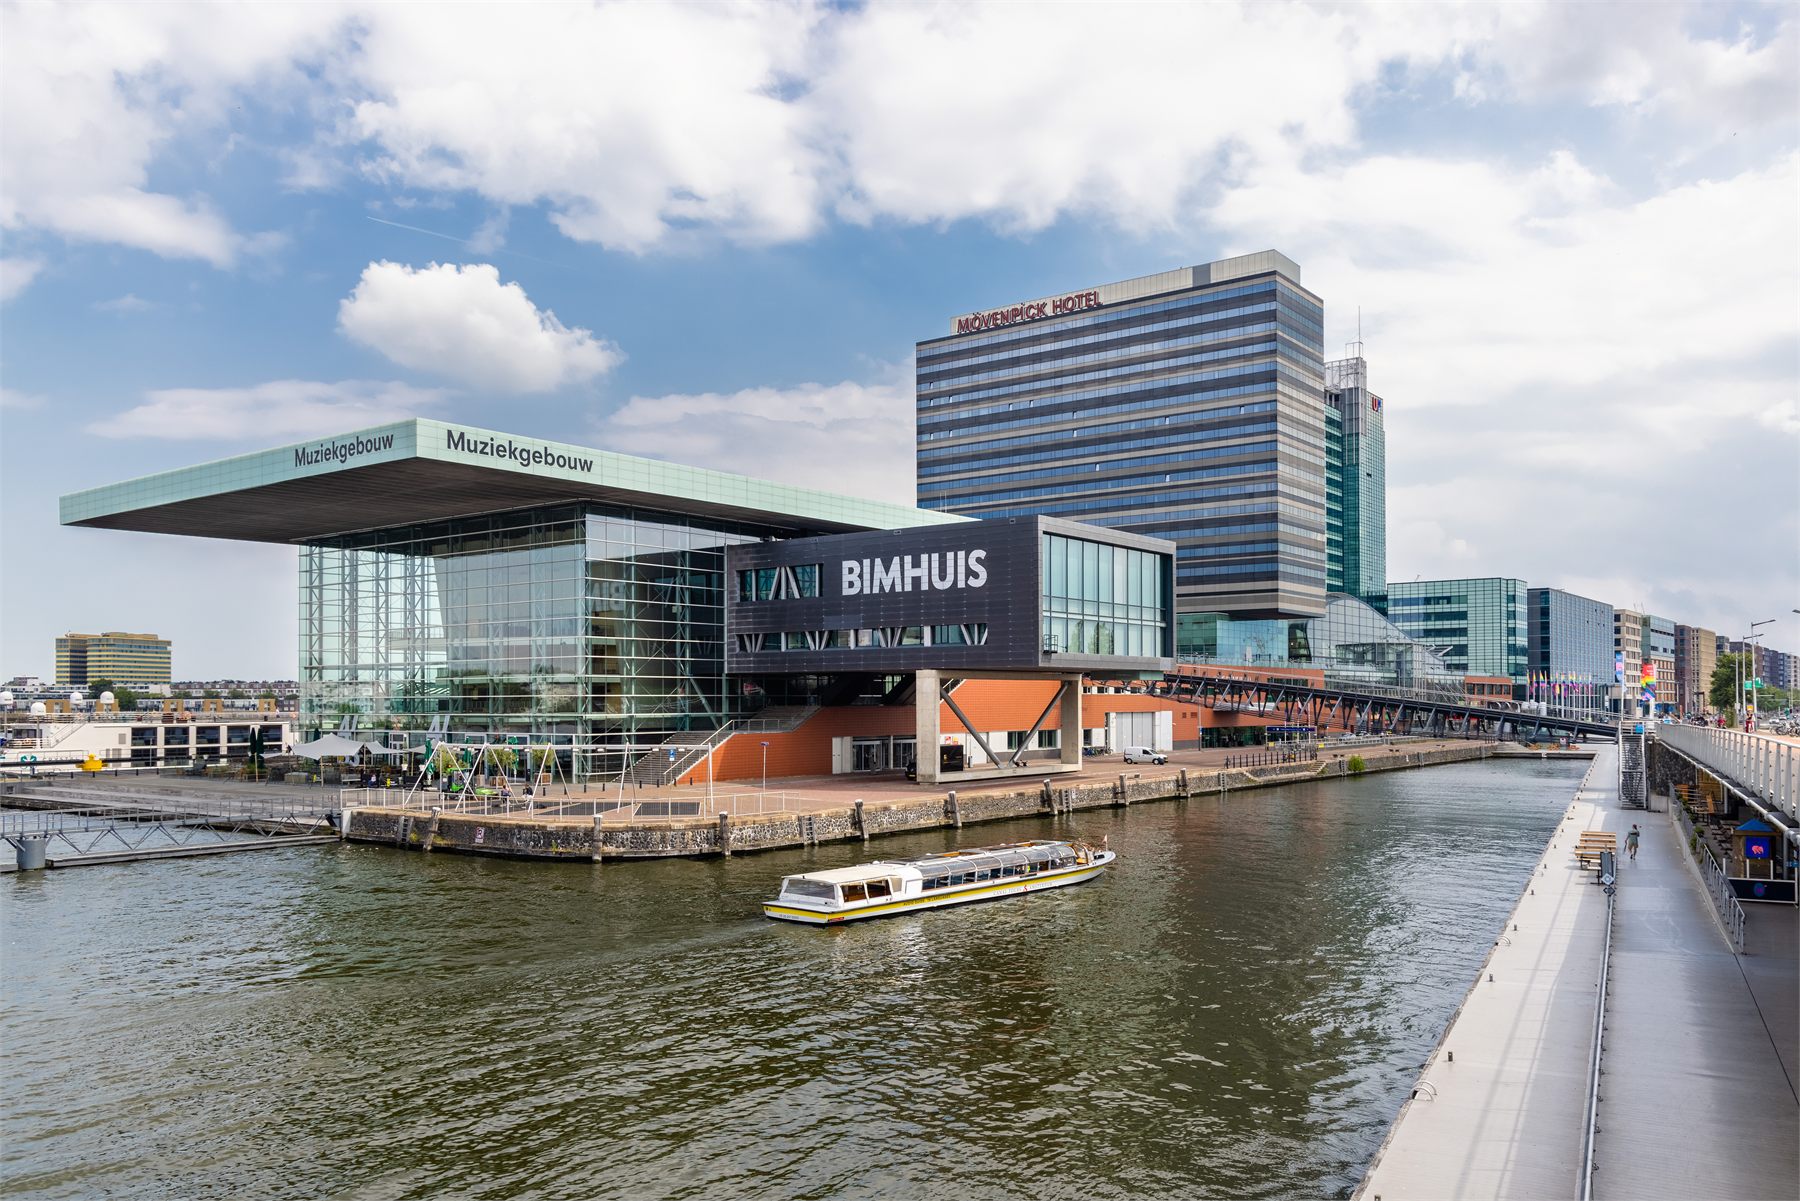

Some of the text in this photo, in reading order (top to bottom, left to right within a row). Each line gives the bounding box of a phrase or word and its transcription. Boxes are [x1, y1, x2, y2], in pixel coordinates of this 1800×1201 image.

[957, 290, 1103, 334] MÖVENPICK HOTEL
[294, 433, 394, 468] Muziekgebouw
[446, 429, 594, 473] Muziekgebouw
[841, 549, 988, 596] BIMHUIS
